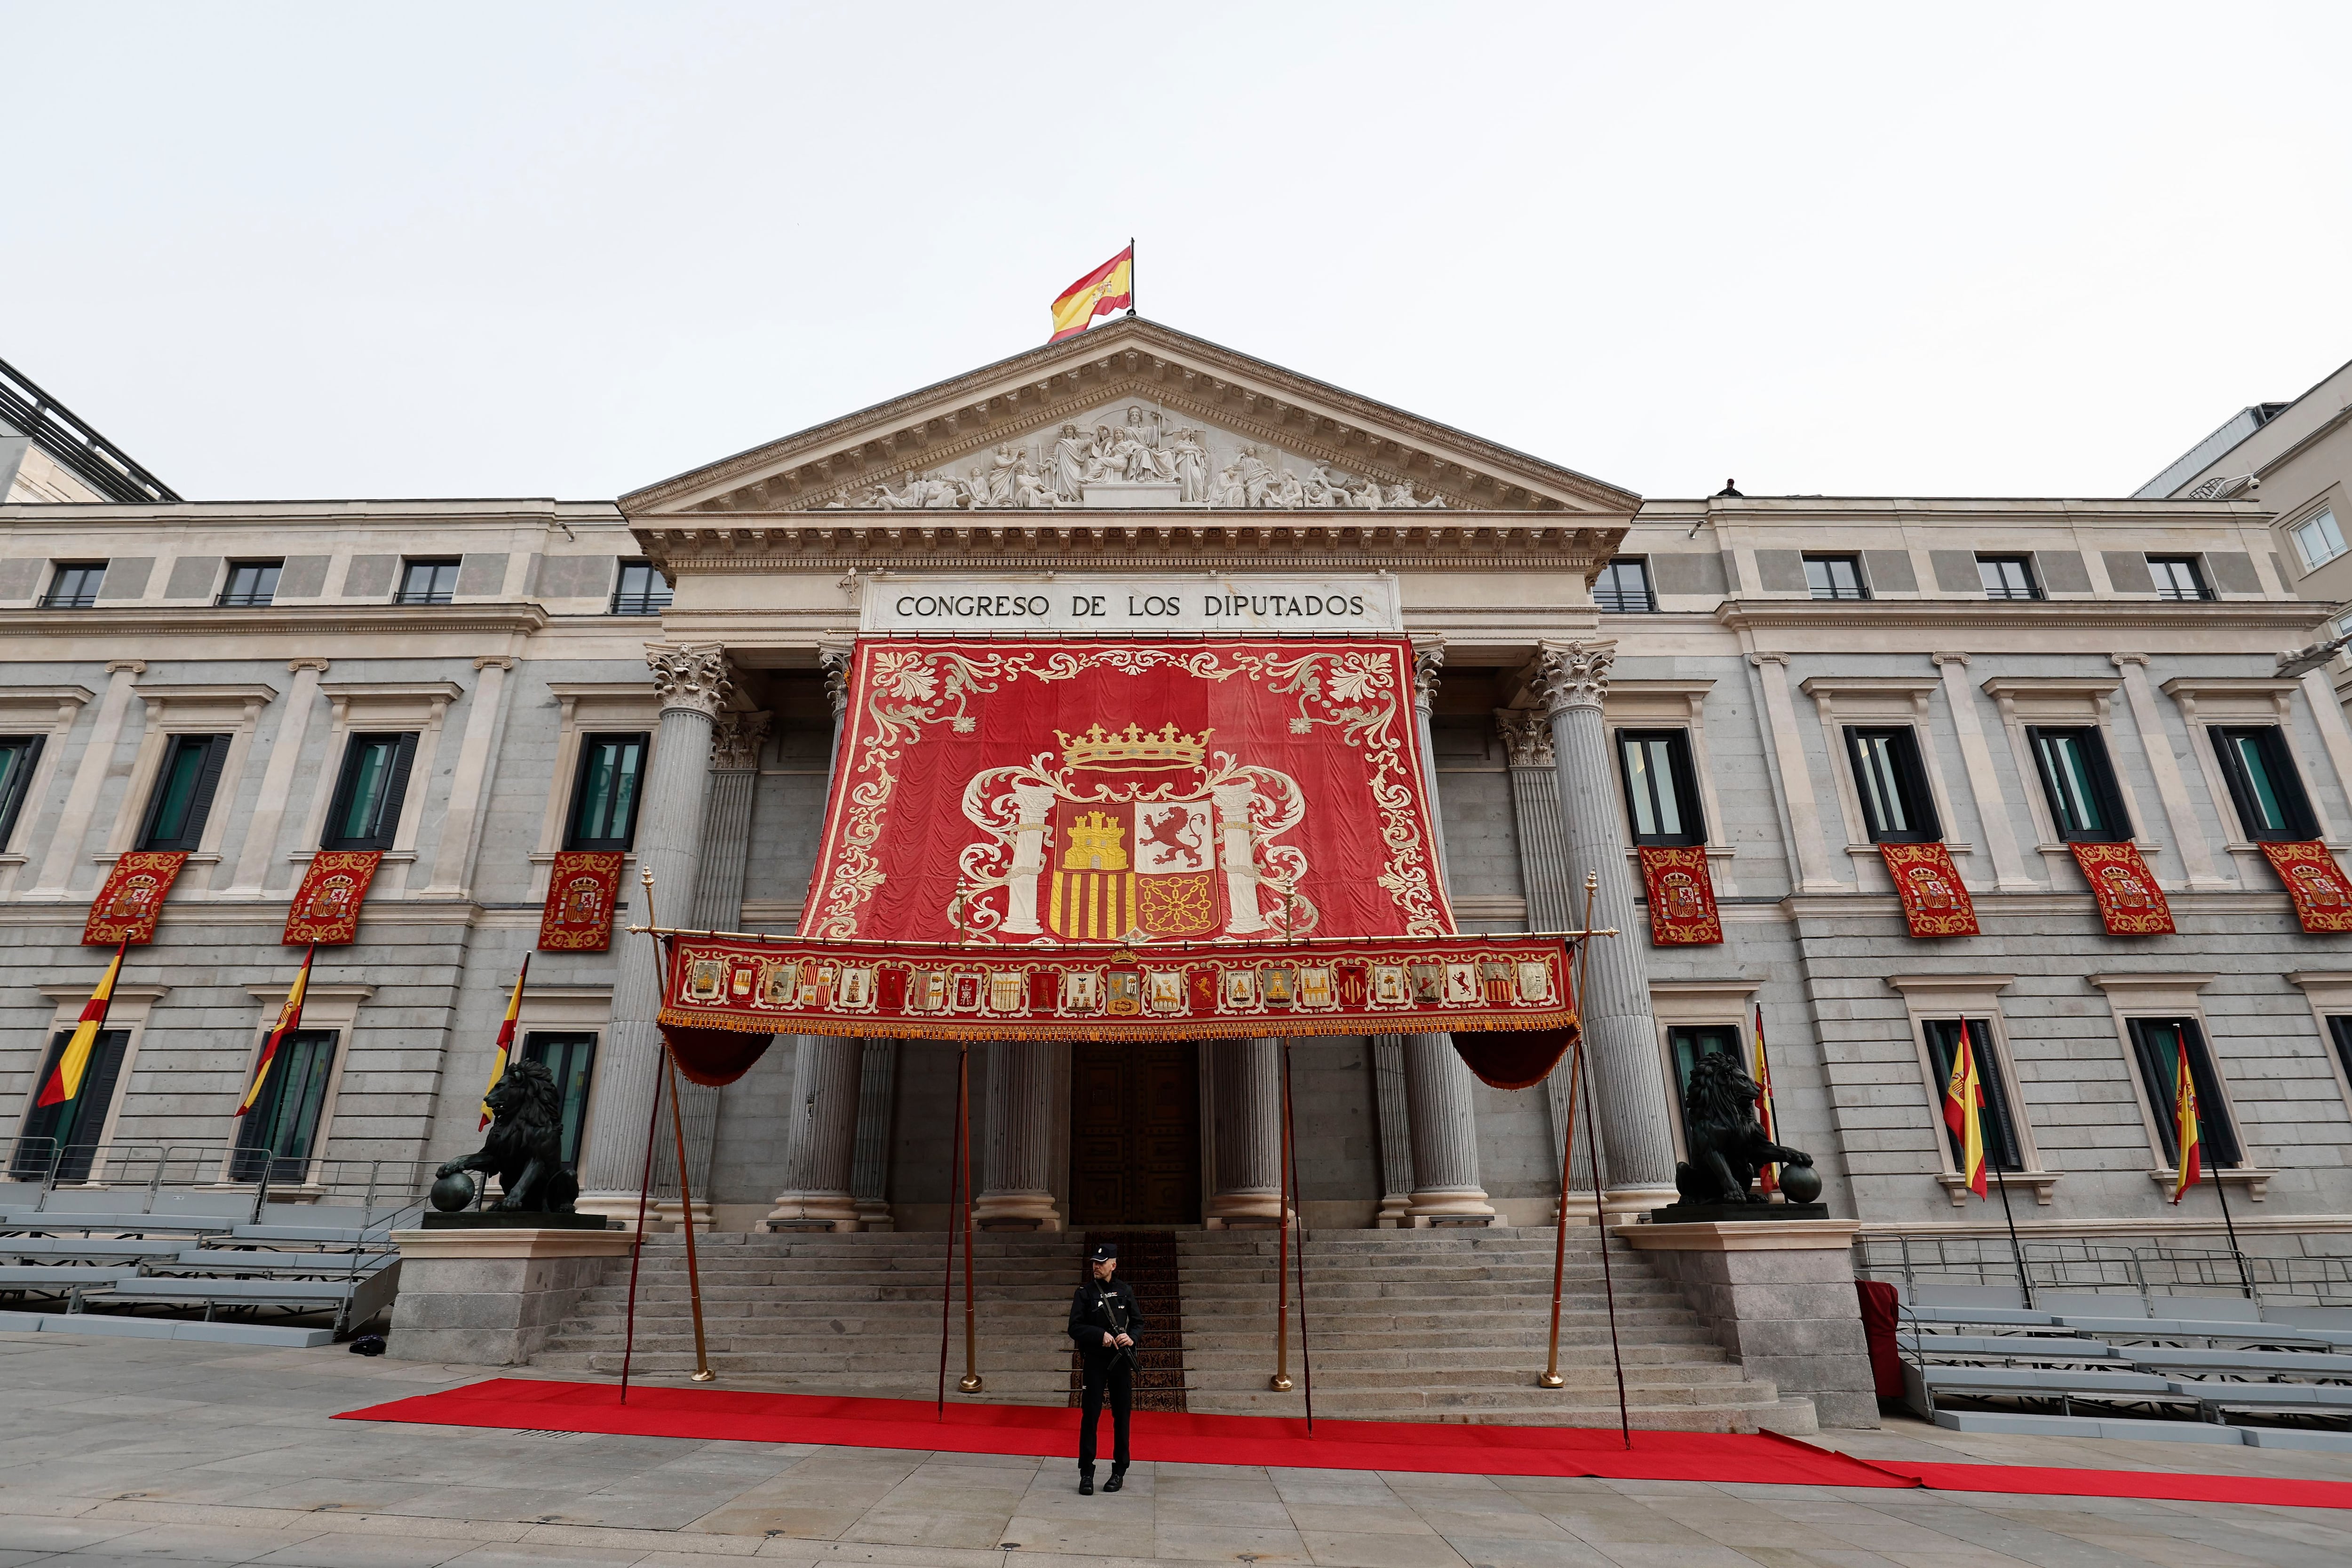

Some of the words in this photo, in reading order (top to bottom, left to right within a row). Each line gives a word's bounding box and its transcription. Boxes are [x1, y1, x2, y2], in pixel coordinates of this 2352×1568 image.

[897, 596, 1049, 616] CONGRESO
[1072, 596, 1105, 616] DE
[1128, 596, 1180, 616] LOS
[1204, 596, 1364, 616] DIPUTADOS
